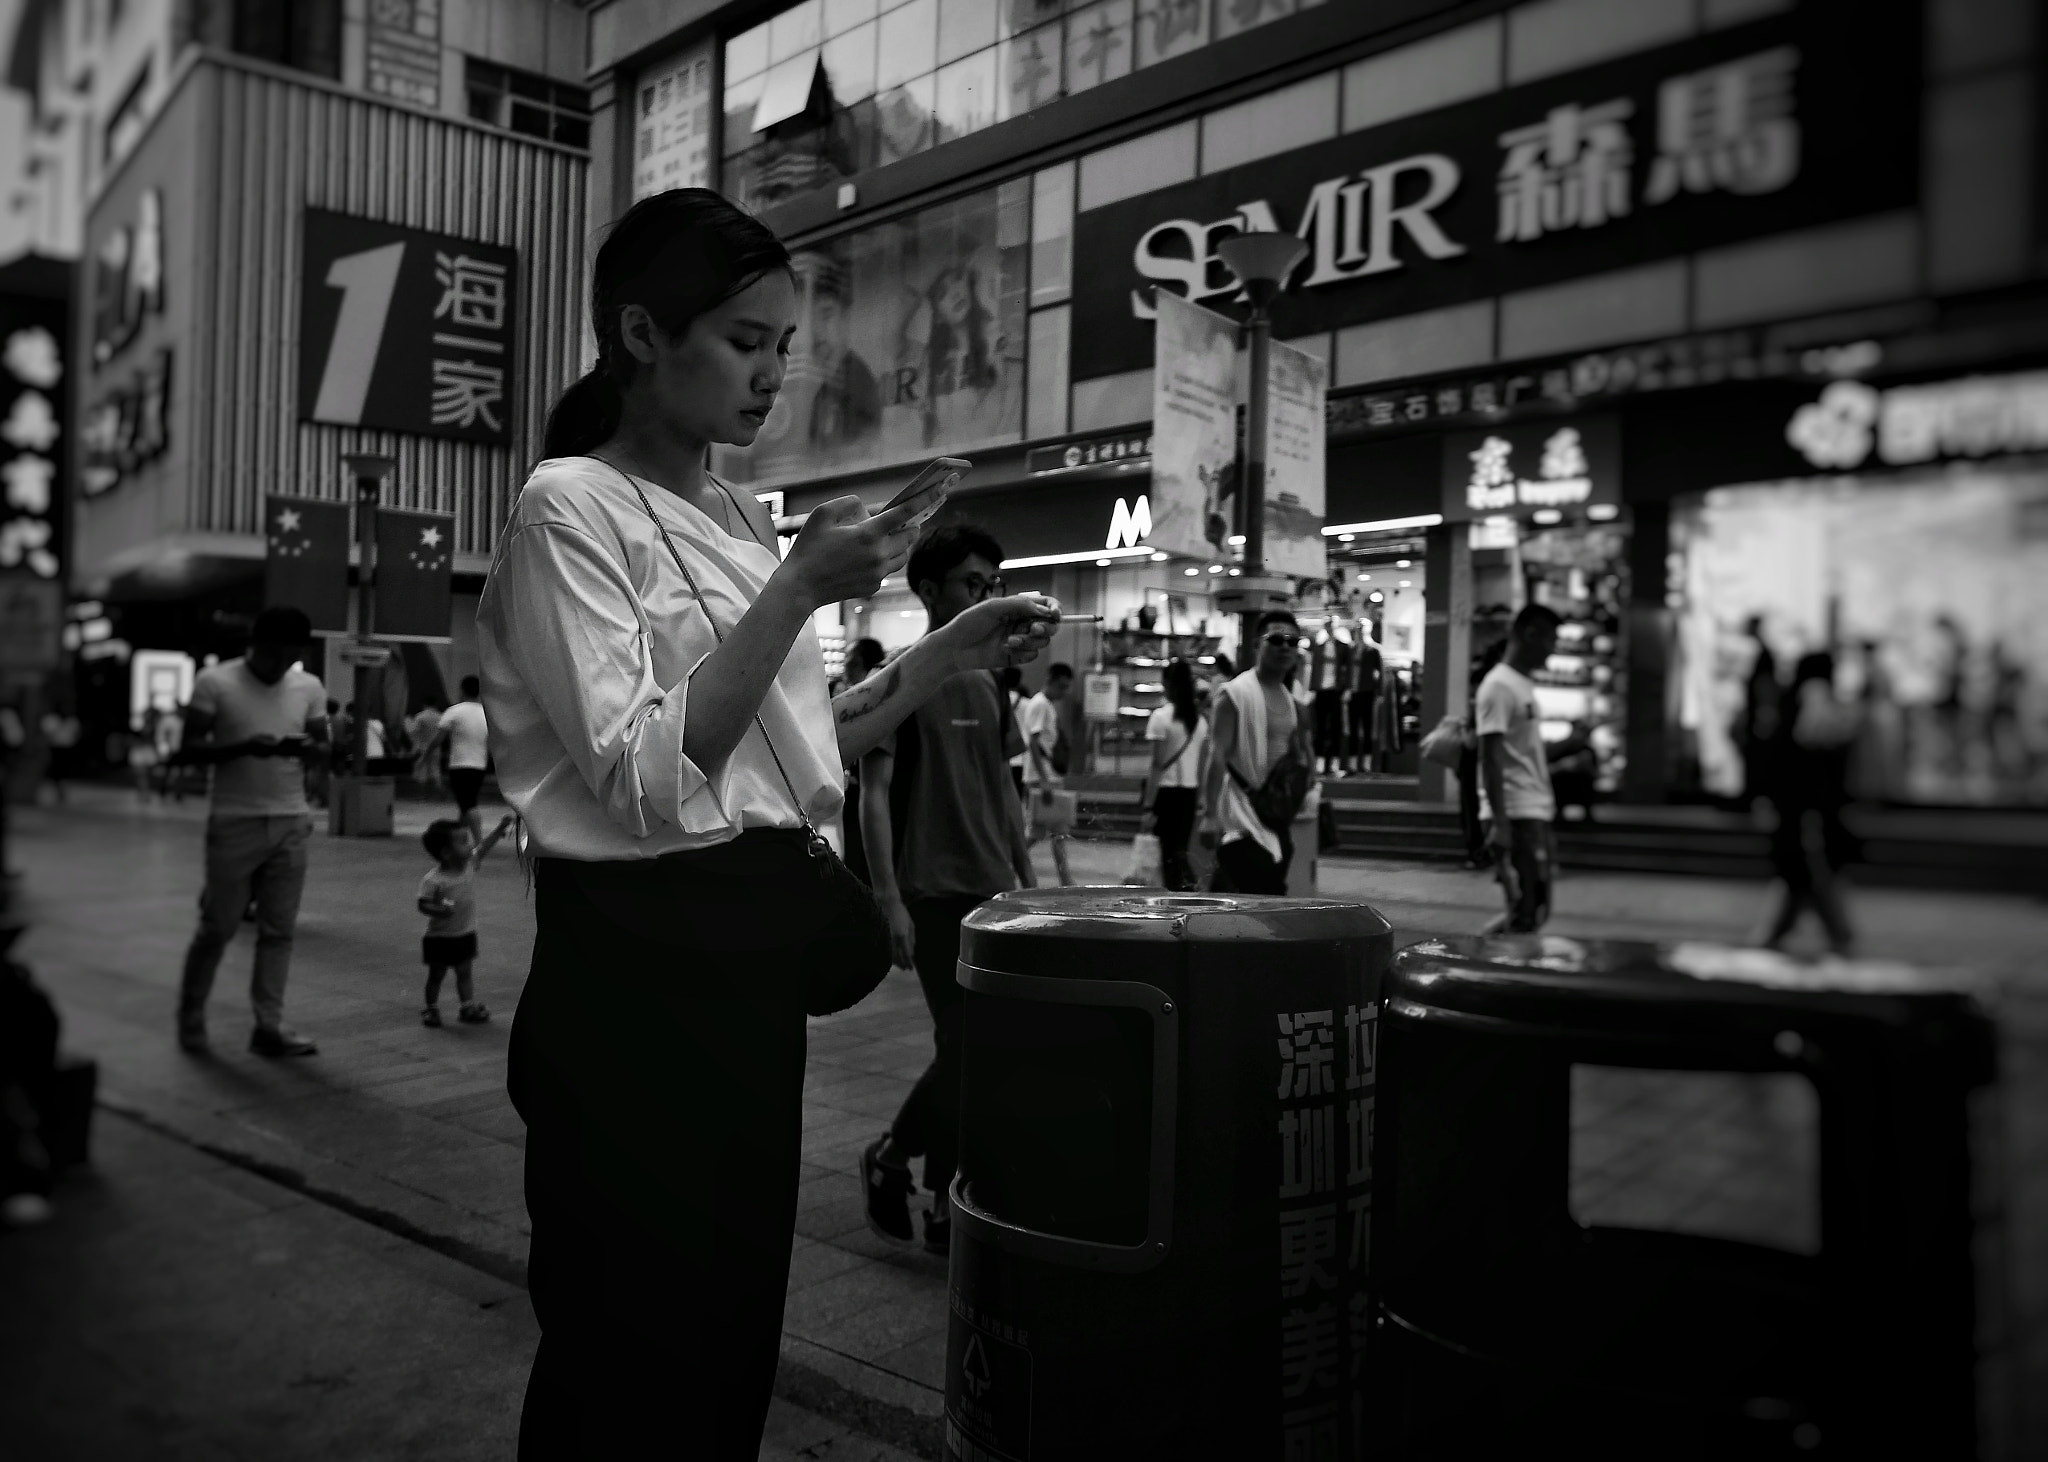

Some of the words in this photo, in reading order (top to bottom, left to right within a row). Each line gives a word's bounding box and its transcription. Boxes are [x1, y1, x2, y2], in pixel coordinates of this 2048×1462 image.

[1494, 41, 1803, 245] 森馬
[1130, 153, 1469, 320] SEMIR
[429, 249, 508, 434] 海一家
